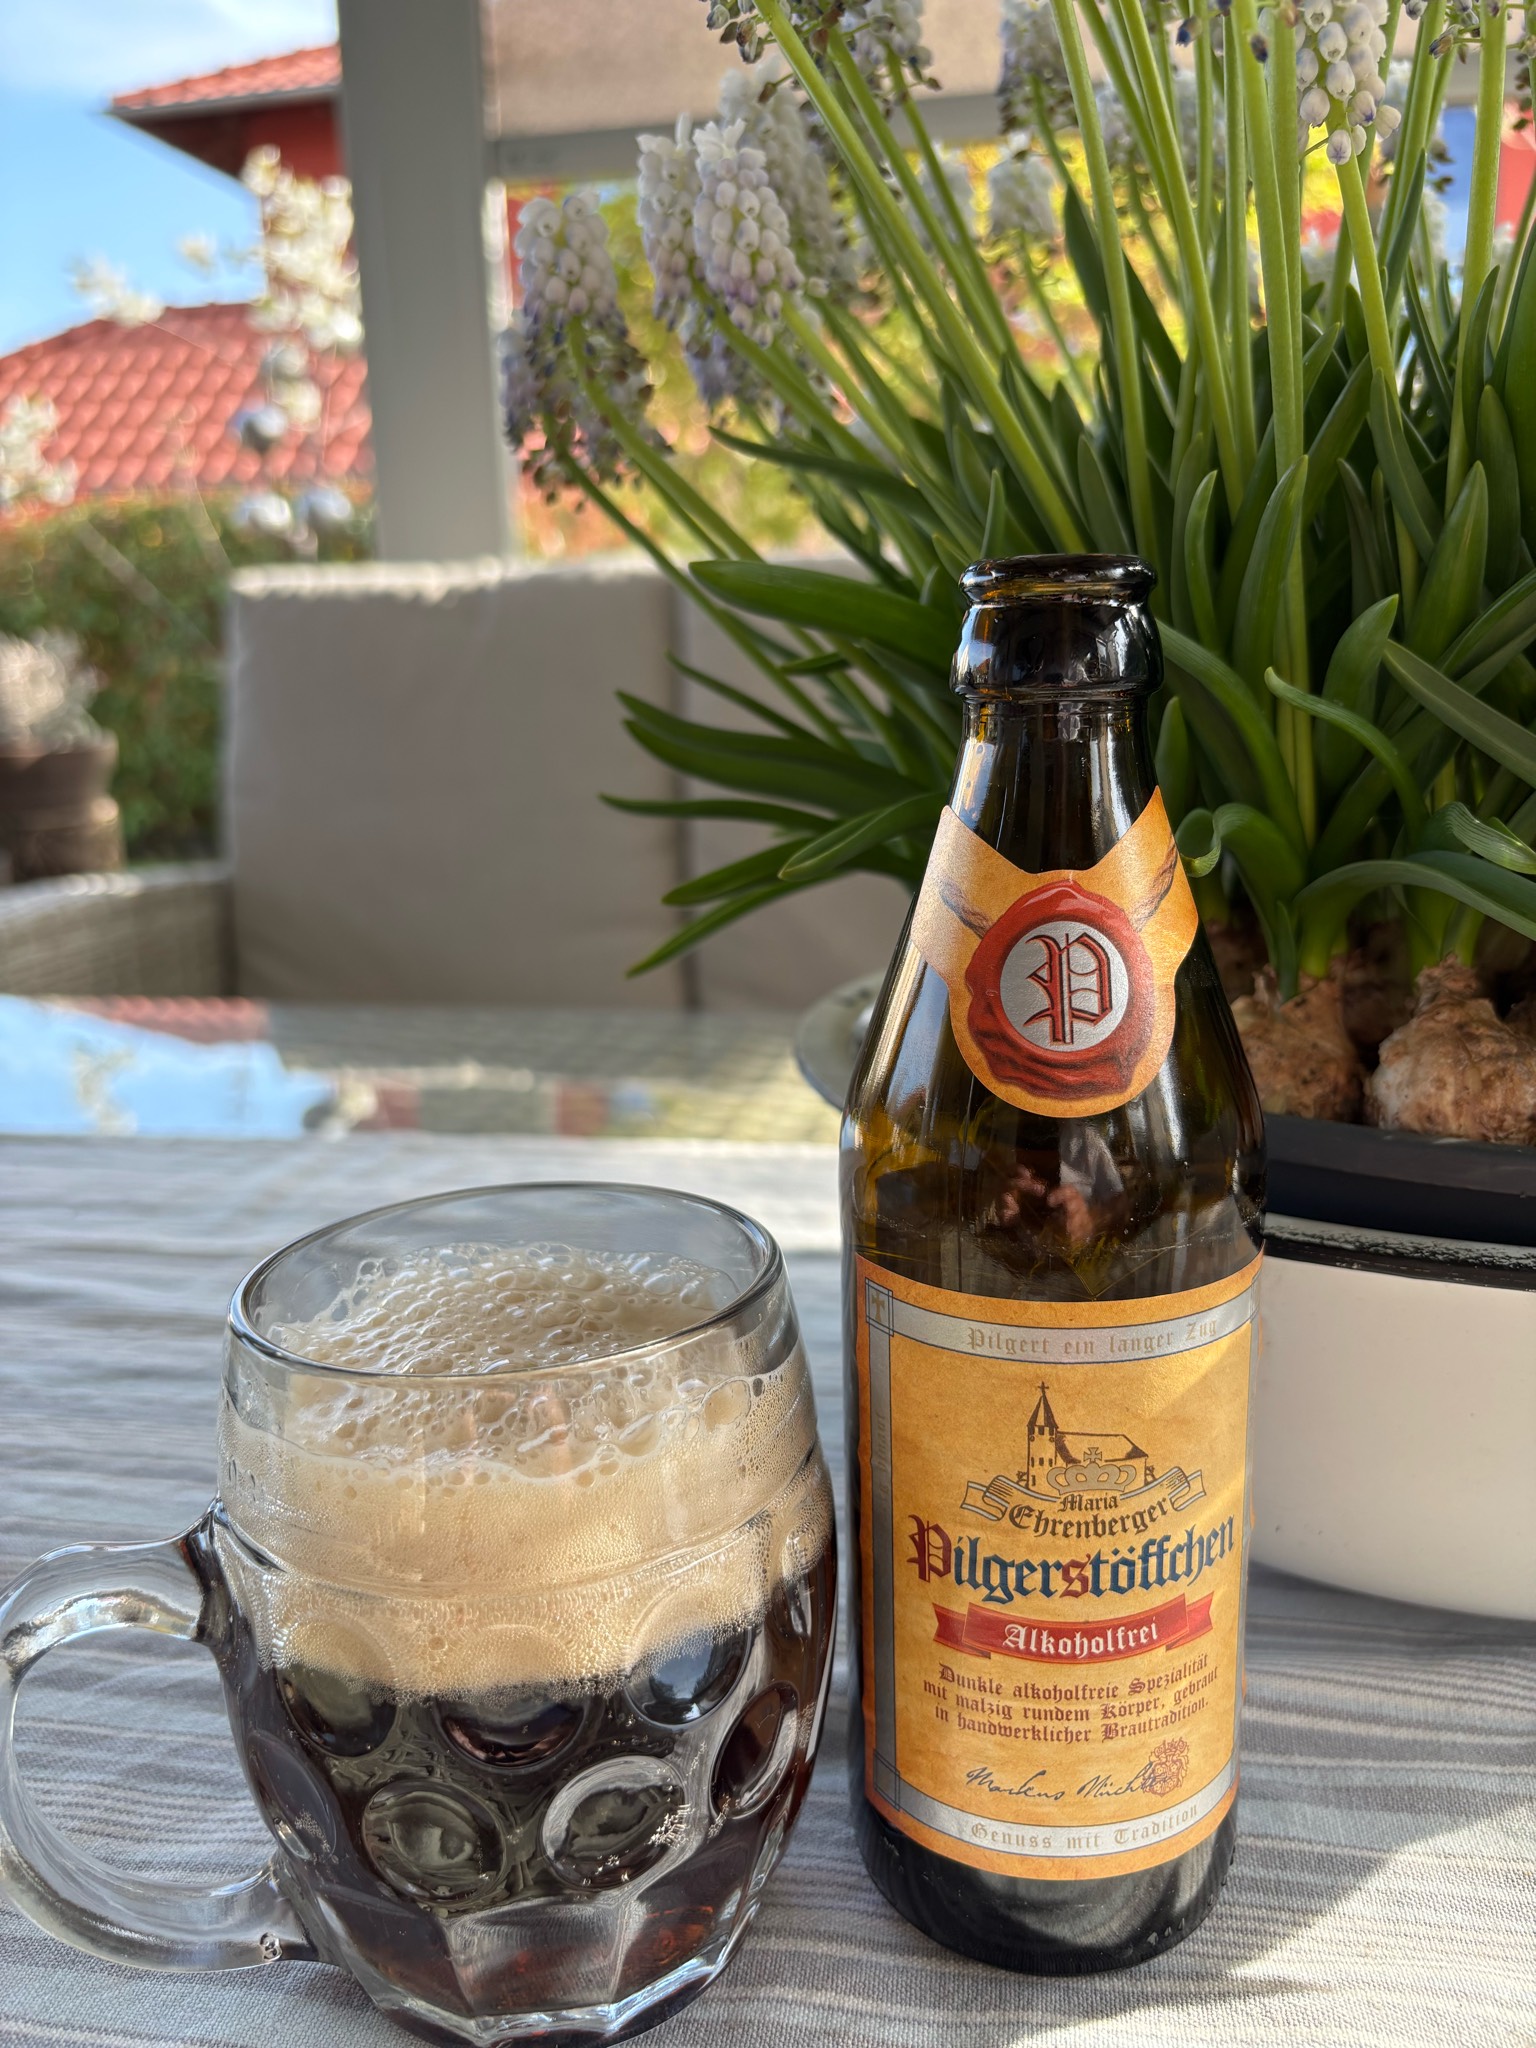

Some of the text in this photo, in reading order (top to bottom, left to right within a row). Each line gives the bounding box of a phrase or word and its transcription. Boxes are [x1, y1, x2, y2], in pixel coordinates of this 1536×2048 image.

[1022, 931, 1114, 1046] P
[967, 1318, 1218, 1356] Pilgert ein langer Zug
[1008, 1497, 1168, 1539] Ehrenberger
[1057, 1492, 1119, 1512] Maria
[906, 1513, 1235, 1605] Pilgerstöffchen
[1002, 1617, 1159, 1659] Alkoholfrei
[923, 1666, 1219, 1722] mit malzig rundem Körper, gebraut
[938, 1653, 1208, 1704] Dunkle alkoholfreie Spezialität
[935, 1697, 1209, 1745] in handwerklicher Brautradition.
[966, 1766, 1066, 1801] Markus
[971, 1804, 1199, 1850] Genuss mit Tradition
